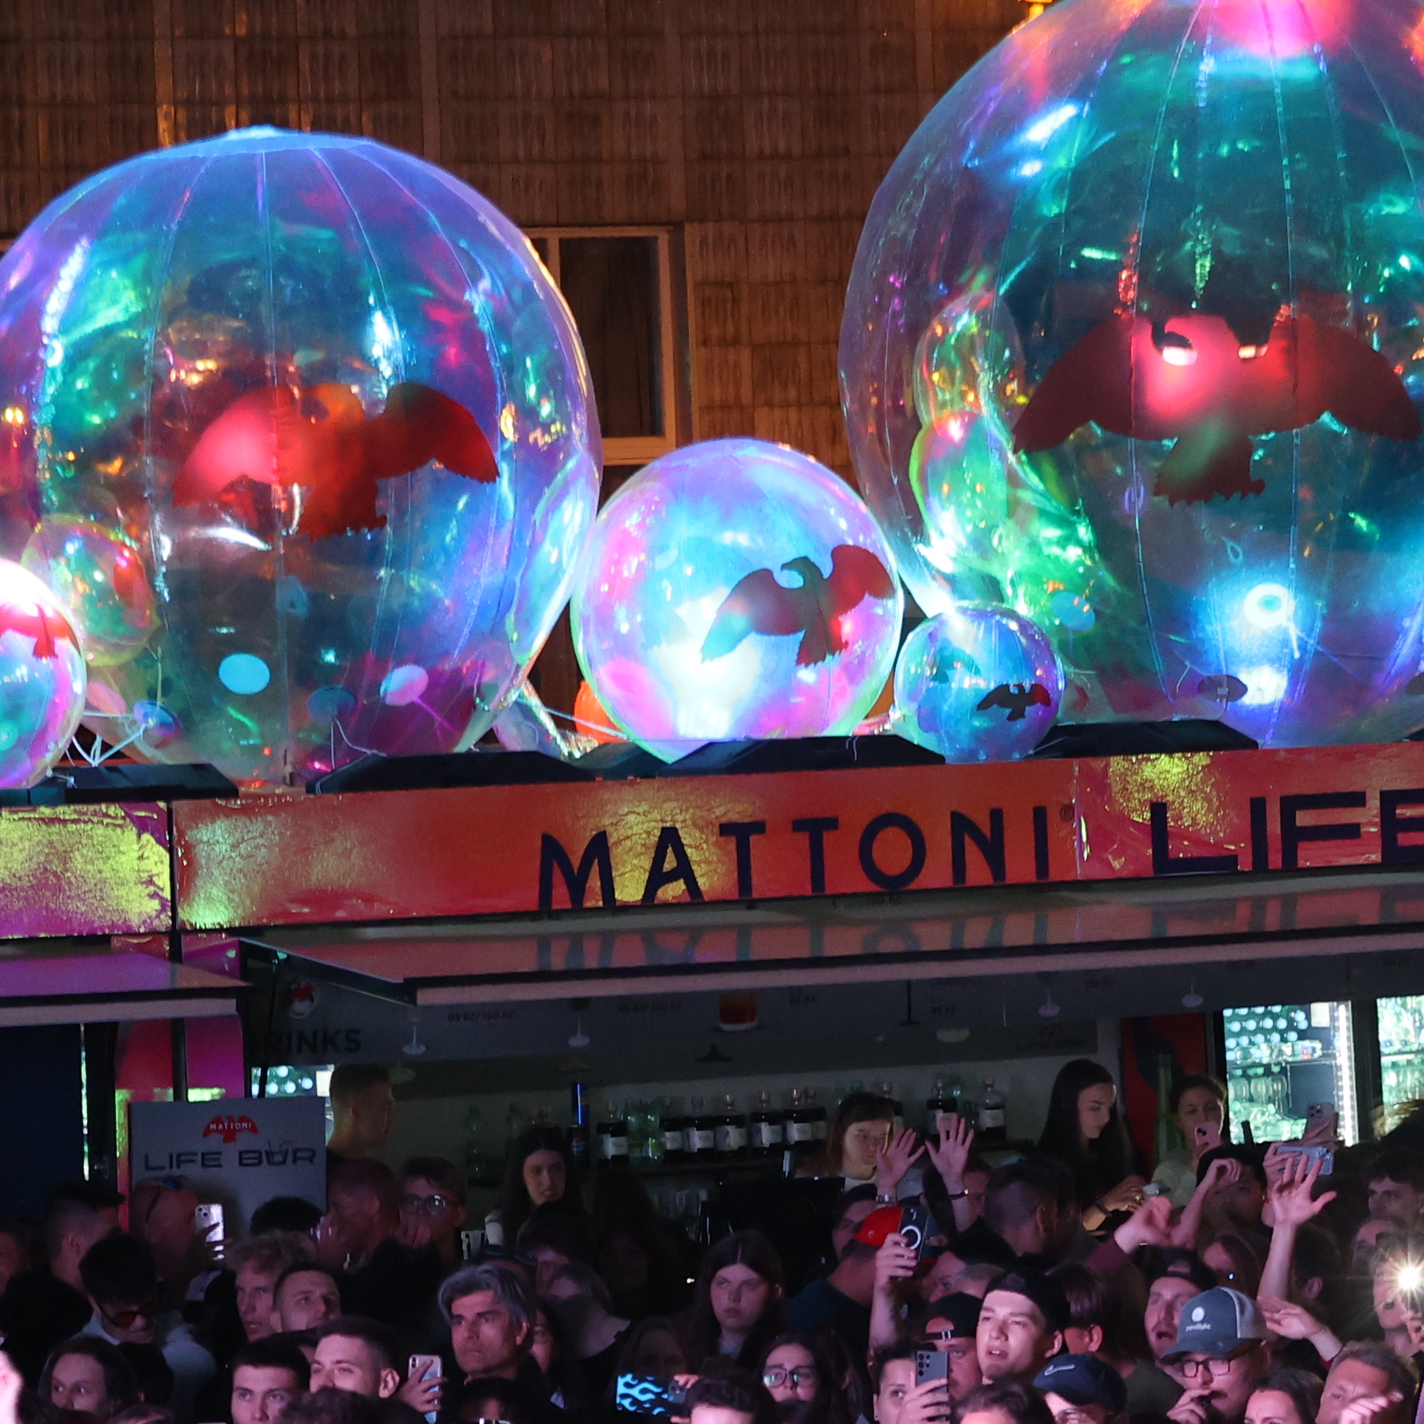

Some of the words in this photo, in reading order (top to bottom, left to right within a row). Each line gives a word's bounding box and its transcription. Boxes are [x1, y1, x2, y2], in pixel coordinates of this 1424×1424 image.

[538, 806, 1049, 910] MATTONI
[256, 1028, 362, 1056] RINKS
[209, 1121, 252, 1131] MATTONI
[144, 1151, 223, 1171] LIFE
